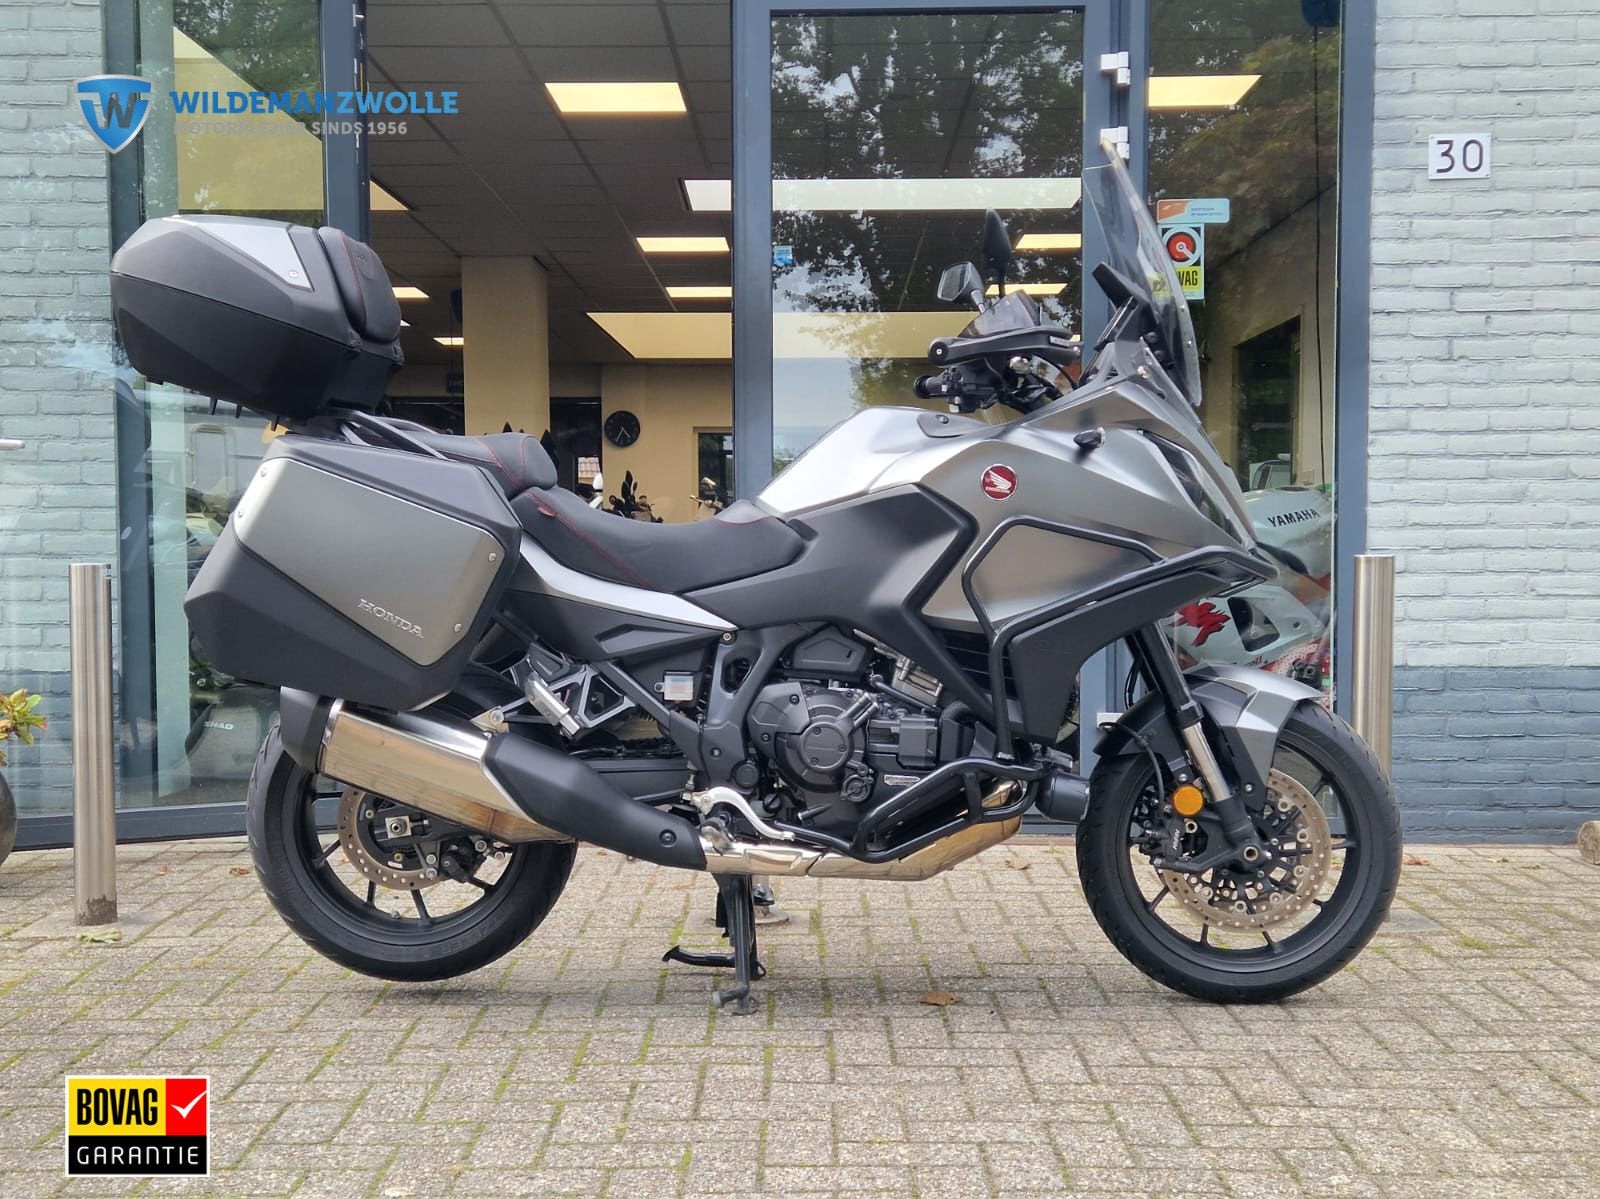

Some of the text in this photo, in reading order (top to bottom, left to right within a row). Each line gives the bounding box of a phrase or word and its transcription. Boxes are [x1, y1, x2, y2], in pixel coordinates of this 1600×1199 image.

[1436, 139, 1483, 173] 30
[1267, 508, 1321, 528] YAMAHA
[357, 598, 424, 639] HONDA
